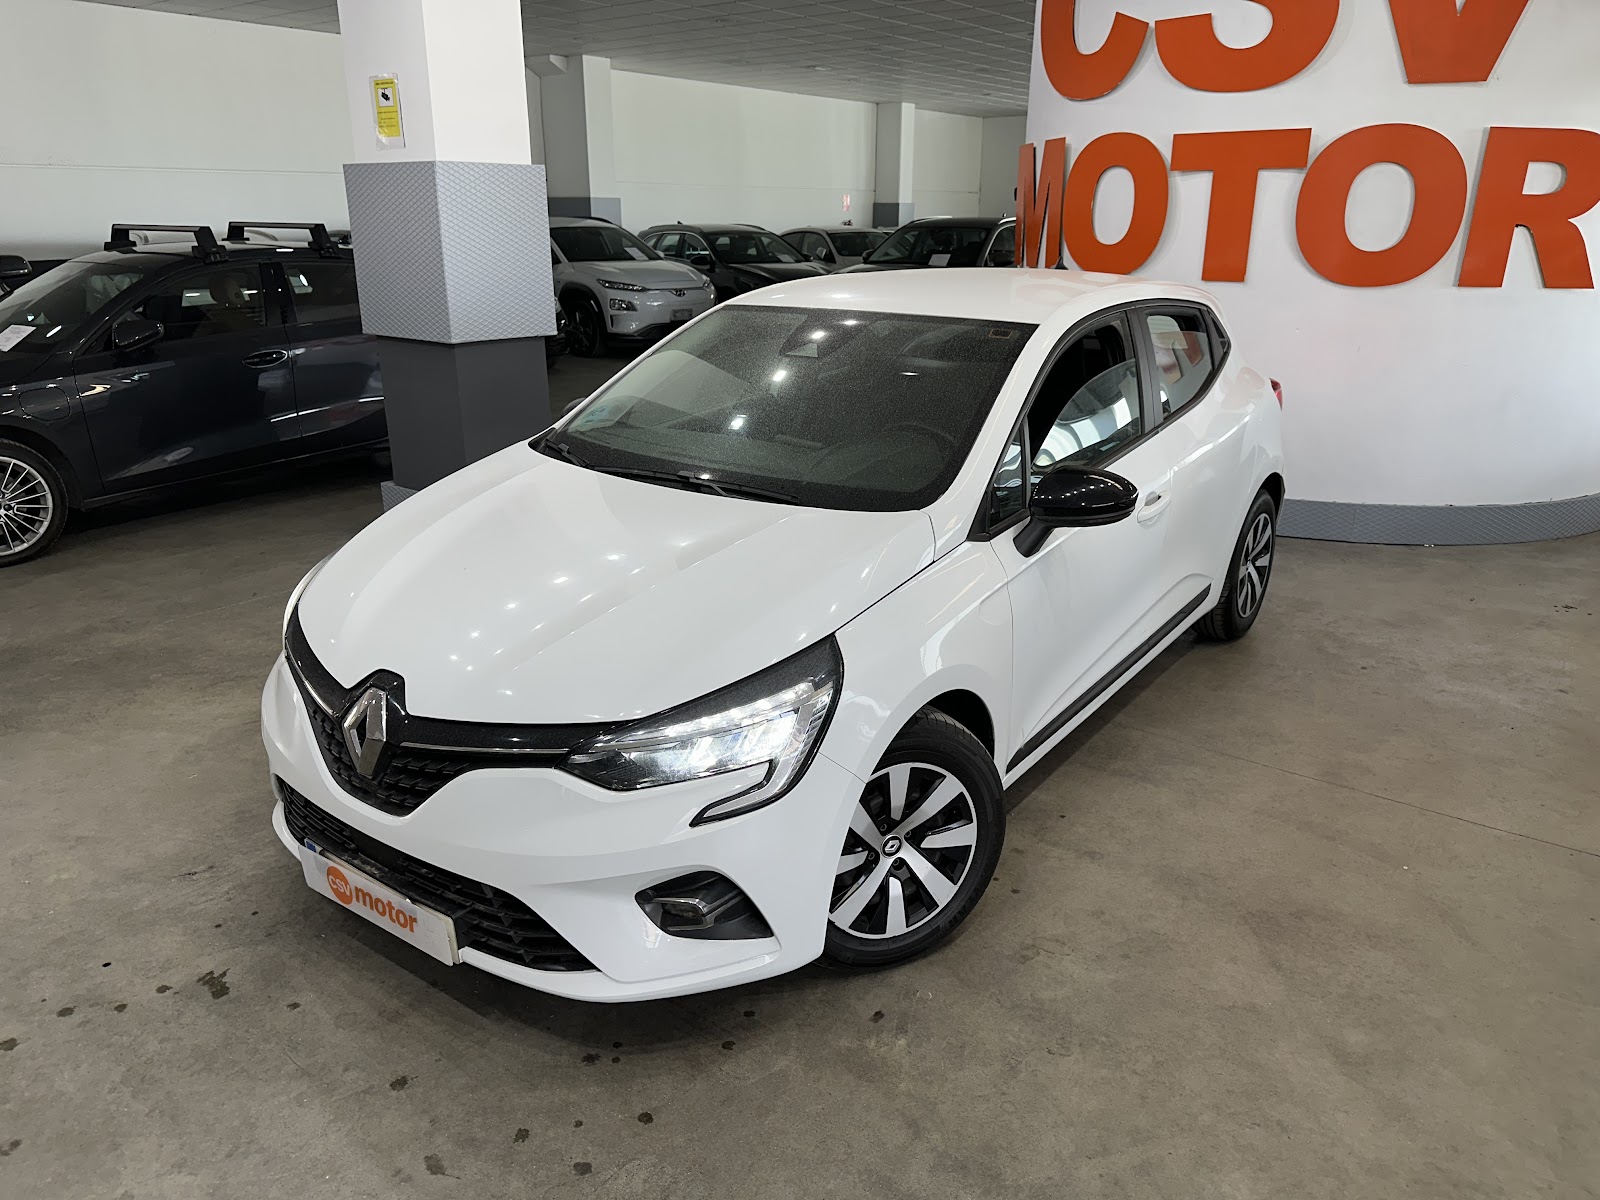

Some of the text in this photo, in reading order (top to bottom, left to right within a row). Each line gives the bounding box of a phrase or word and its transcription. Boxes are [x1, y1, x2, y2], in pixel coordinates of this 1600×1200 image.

[1014, 123, 1600, 289] MOTOR
[328, 875, 418, 934] CSV motor
